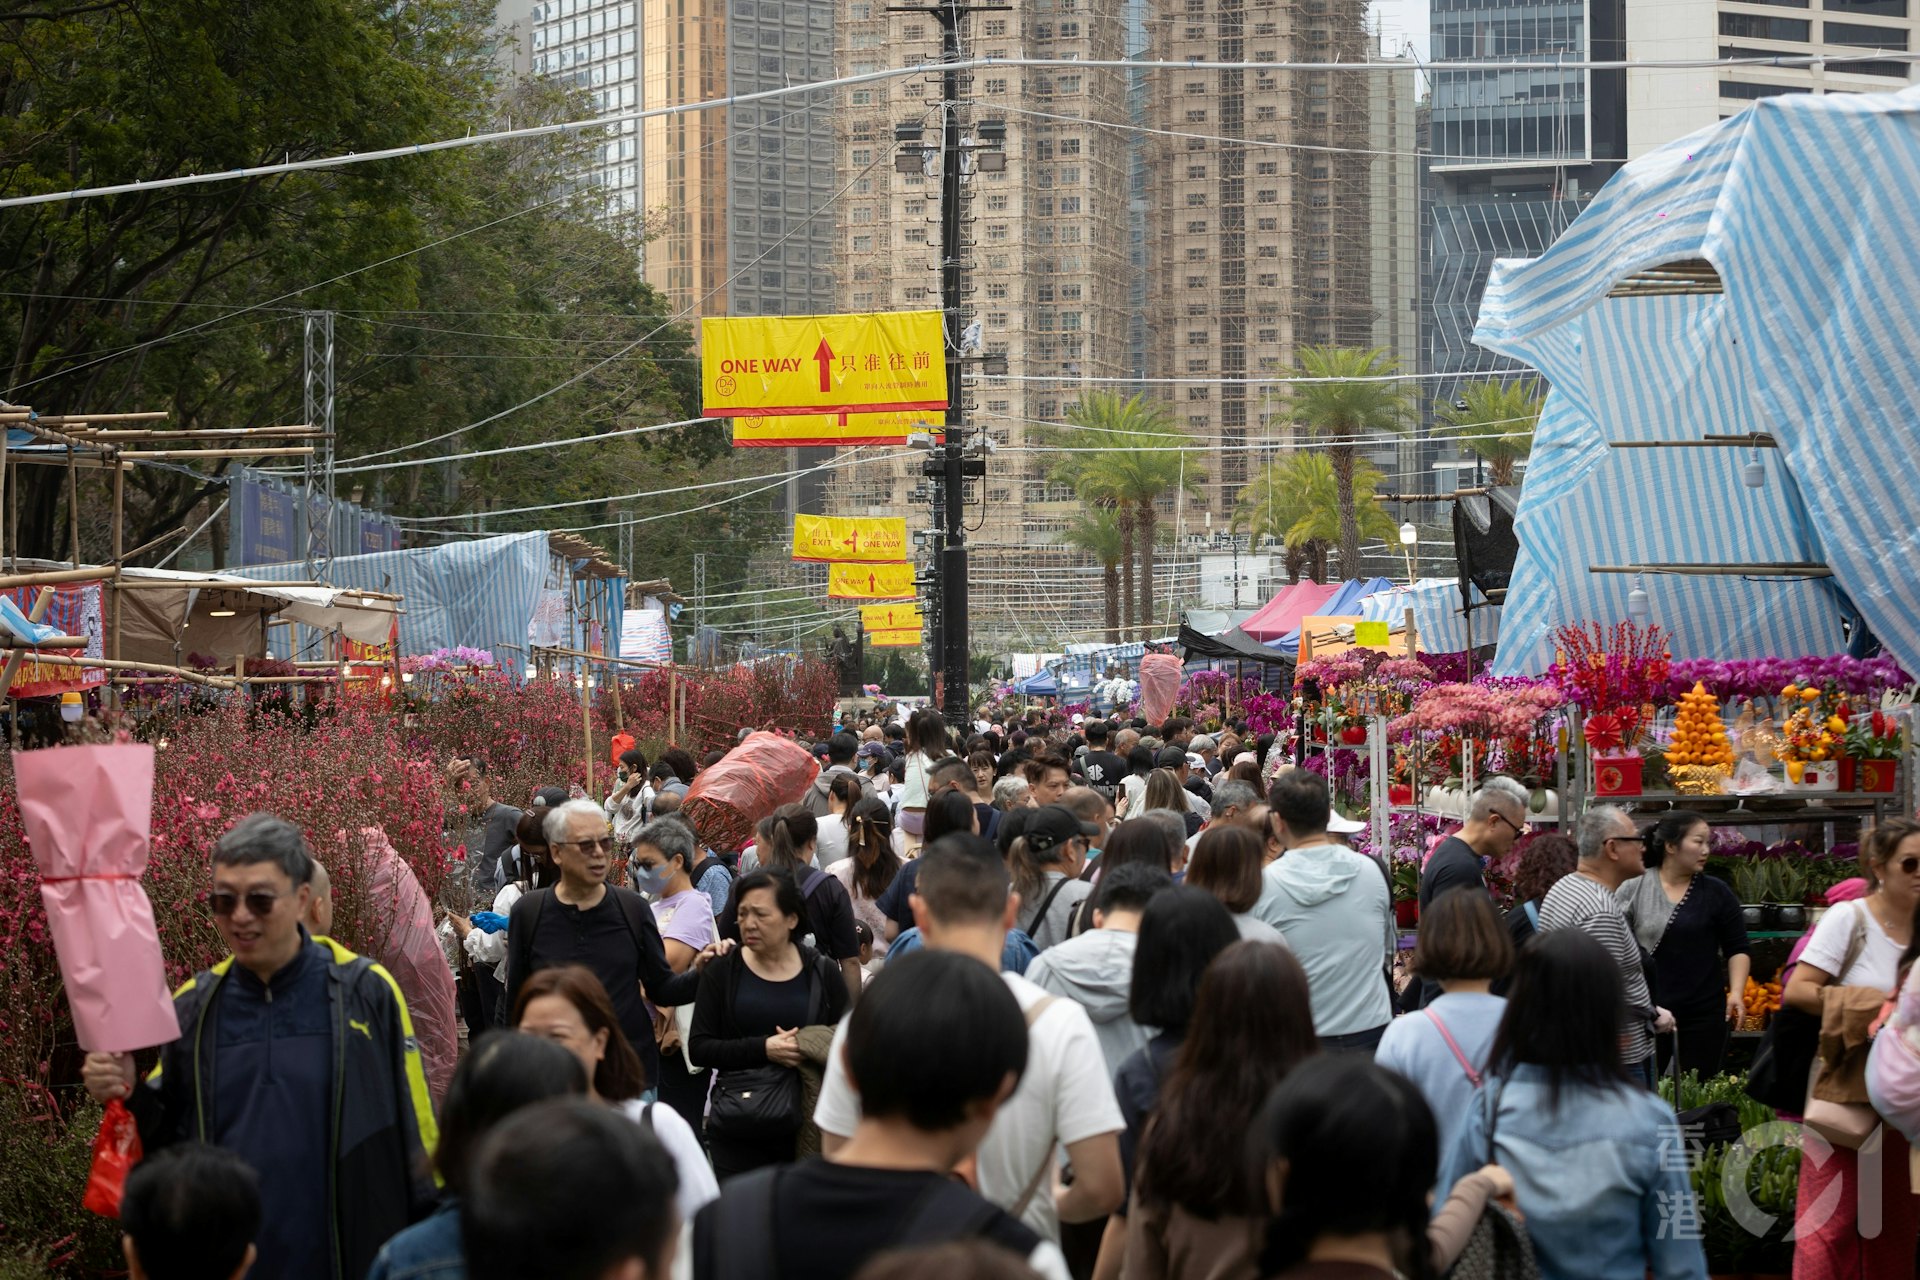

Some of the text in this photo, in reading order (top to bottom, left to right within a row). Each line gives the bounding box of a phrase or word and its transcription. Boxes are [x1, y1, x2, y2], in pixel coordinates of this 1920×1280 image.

[720, 357, 802, 374] ONE WAY
[840, 351, 930, 373] 只准往前
[719, 379, 733, 388] D4
